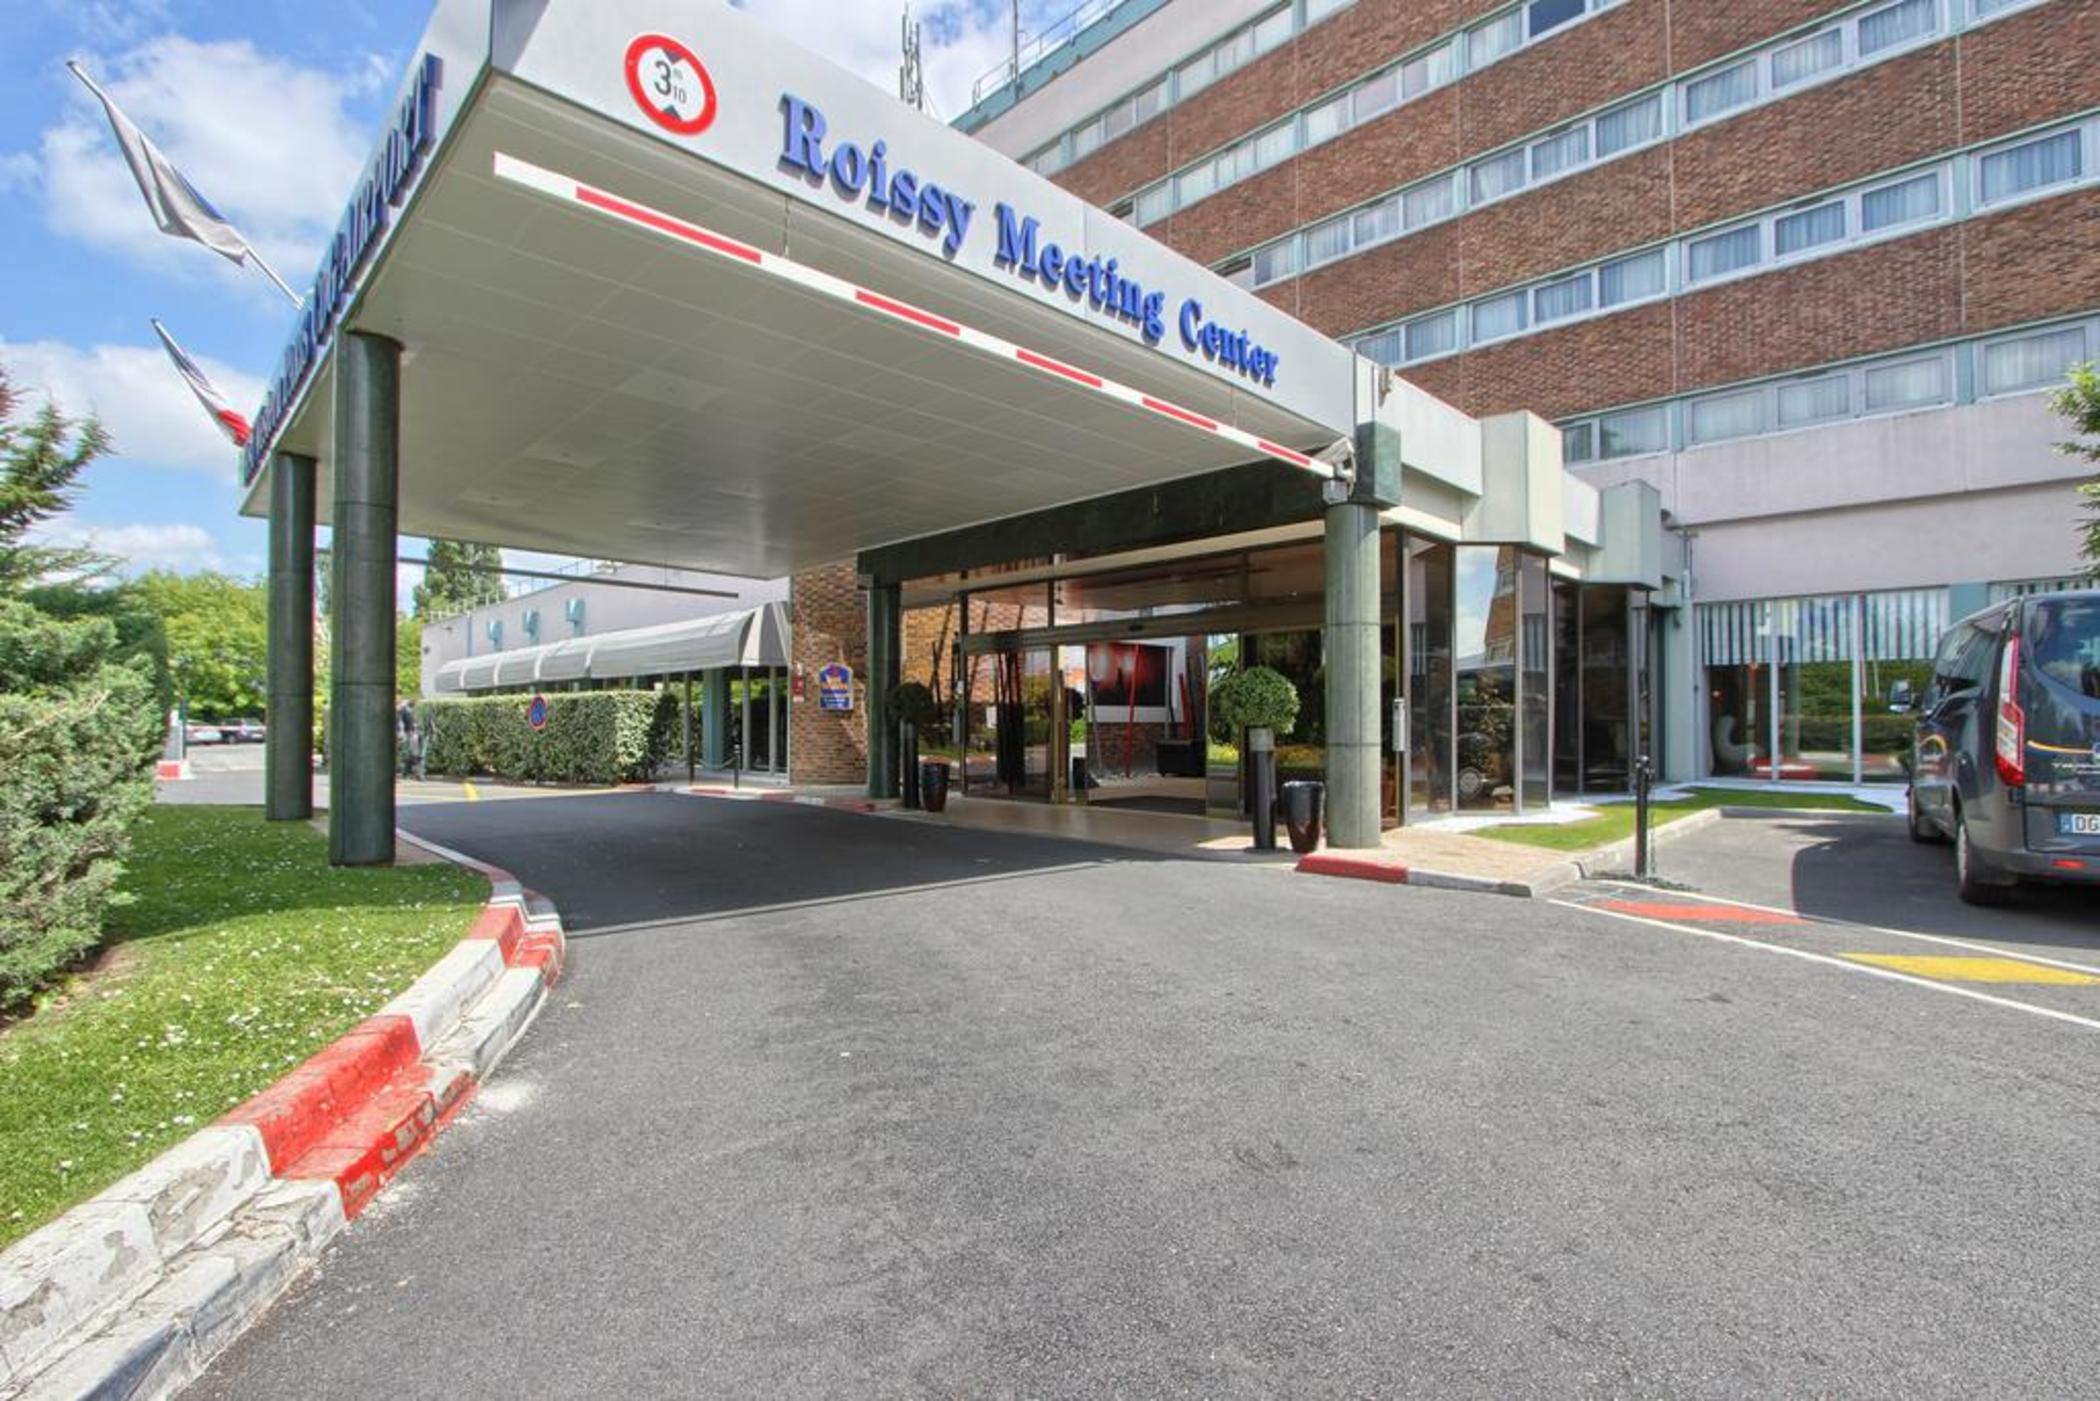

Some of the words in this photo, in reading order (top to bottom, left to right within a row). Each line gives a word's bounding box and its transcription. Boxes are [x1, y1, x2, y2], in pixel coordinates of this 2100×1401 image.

[653, 59, 671, 96] 3
[778, 93, 976, 259] Roissy
[993, 202, 1166, 346] Meeting
[1178, 299, 1279, 388] Center
